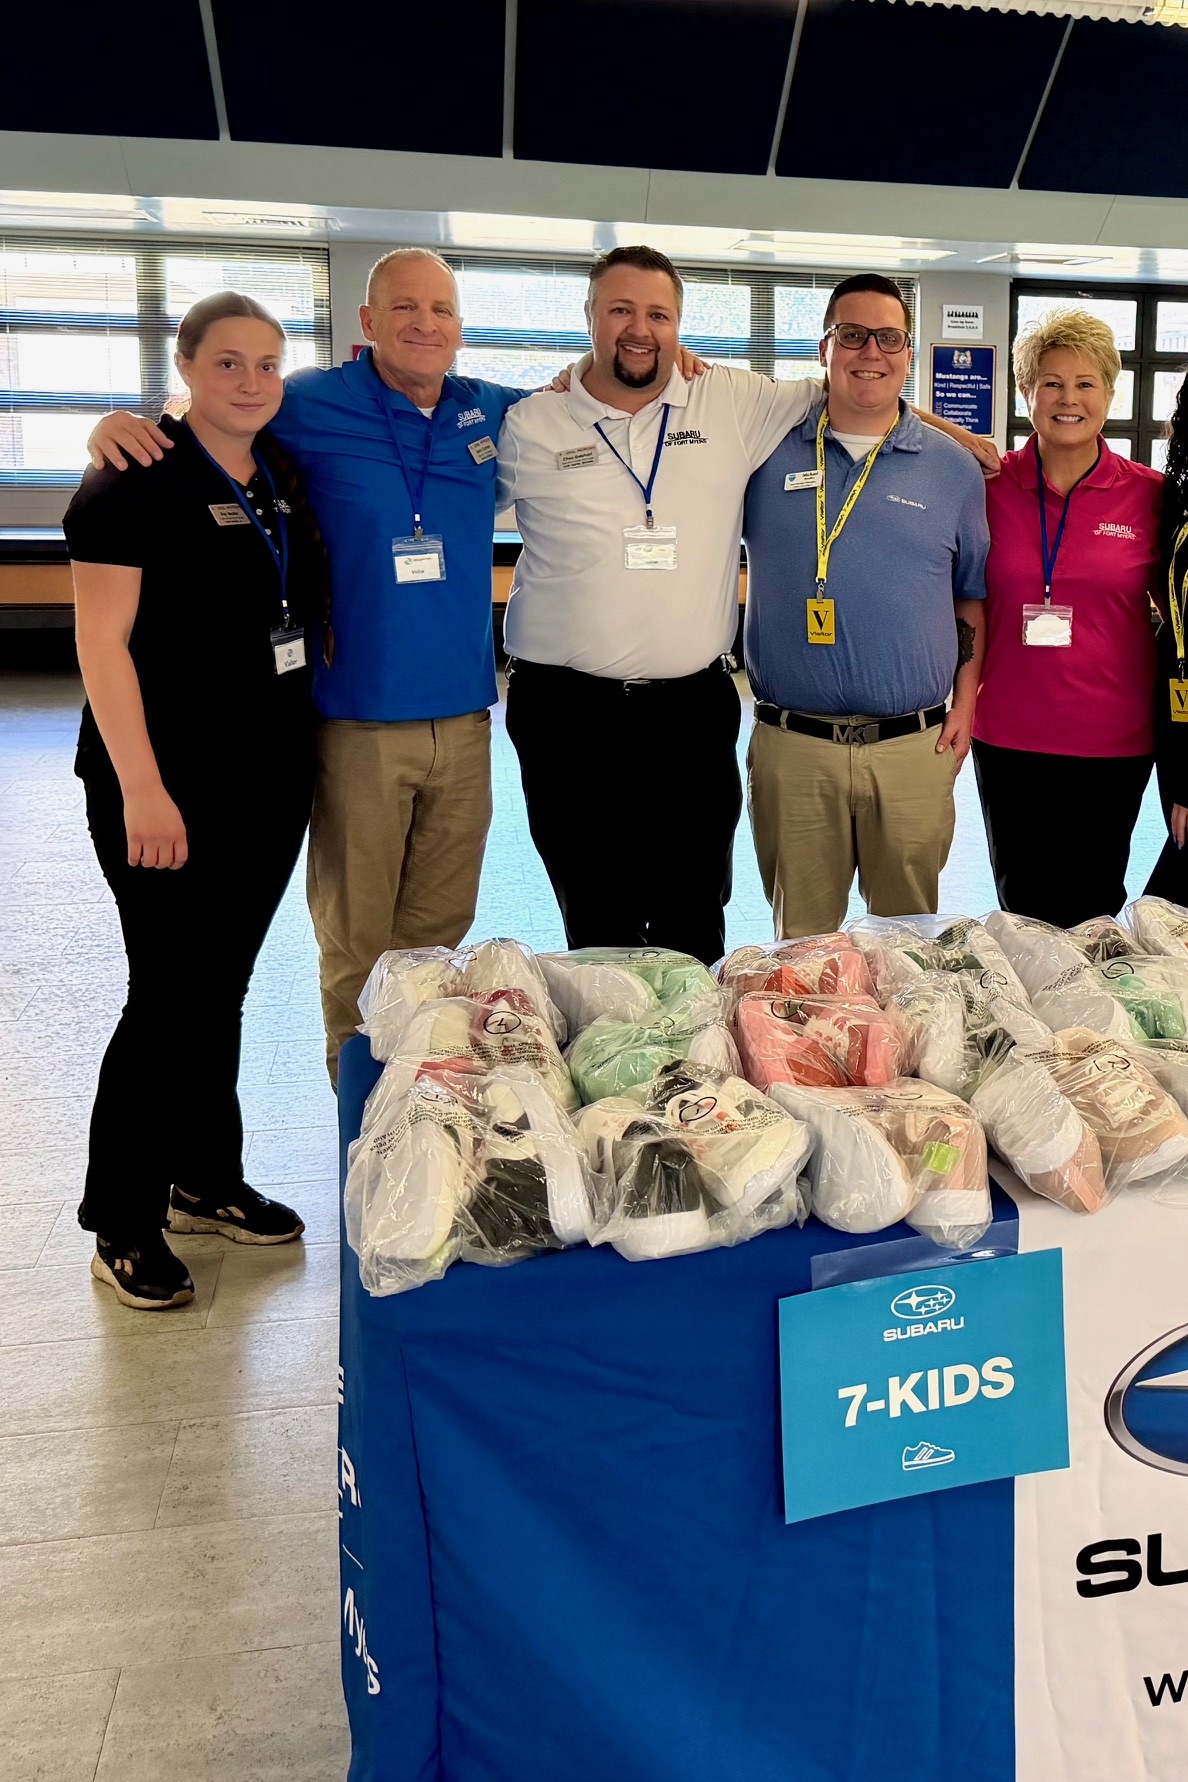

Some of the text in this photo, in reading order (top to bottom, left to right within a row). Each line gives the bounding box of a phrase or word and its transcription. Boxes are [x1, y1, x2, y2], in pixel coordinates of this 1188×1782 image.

[936, 372, 968, 380] Mustangs
[457, 407, 482, 422] SUBARU
[667, 430, 701, 440] SUBARU
[901, 499, 927, 510] SUBARU
[1099, 523, 1132, 533] SUBARU
[812, 610, 830, 630] V
[1174, 690, 1188, 709] V
[833, 724, 865, 744] MK
[883, 1316, 965, 1342] SUBARU
[838, 1356, 1015, 1427] 7-KIDS
